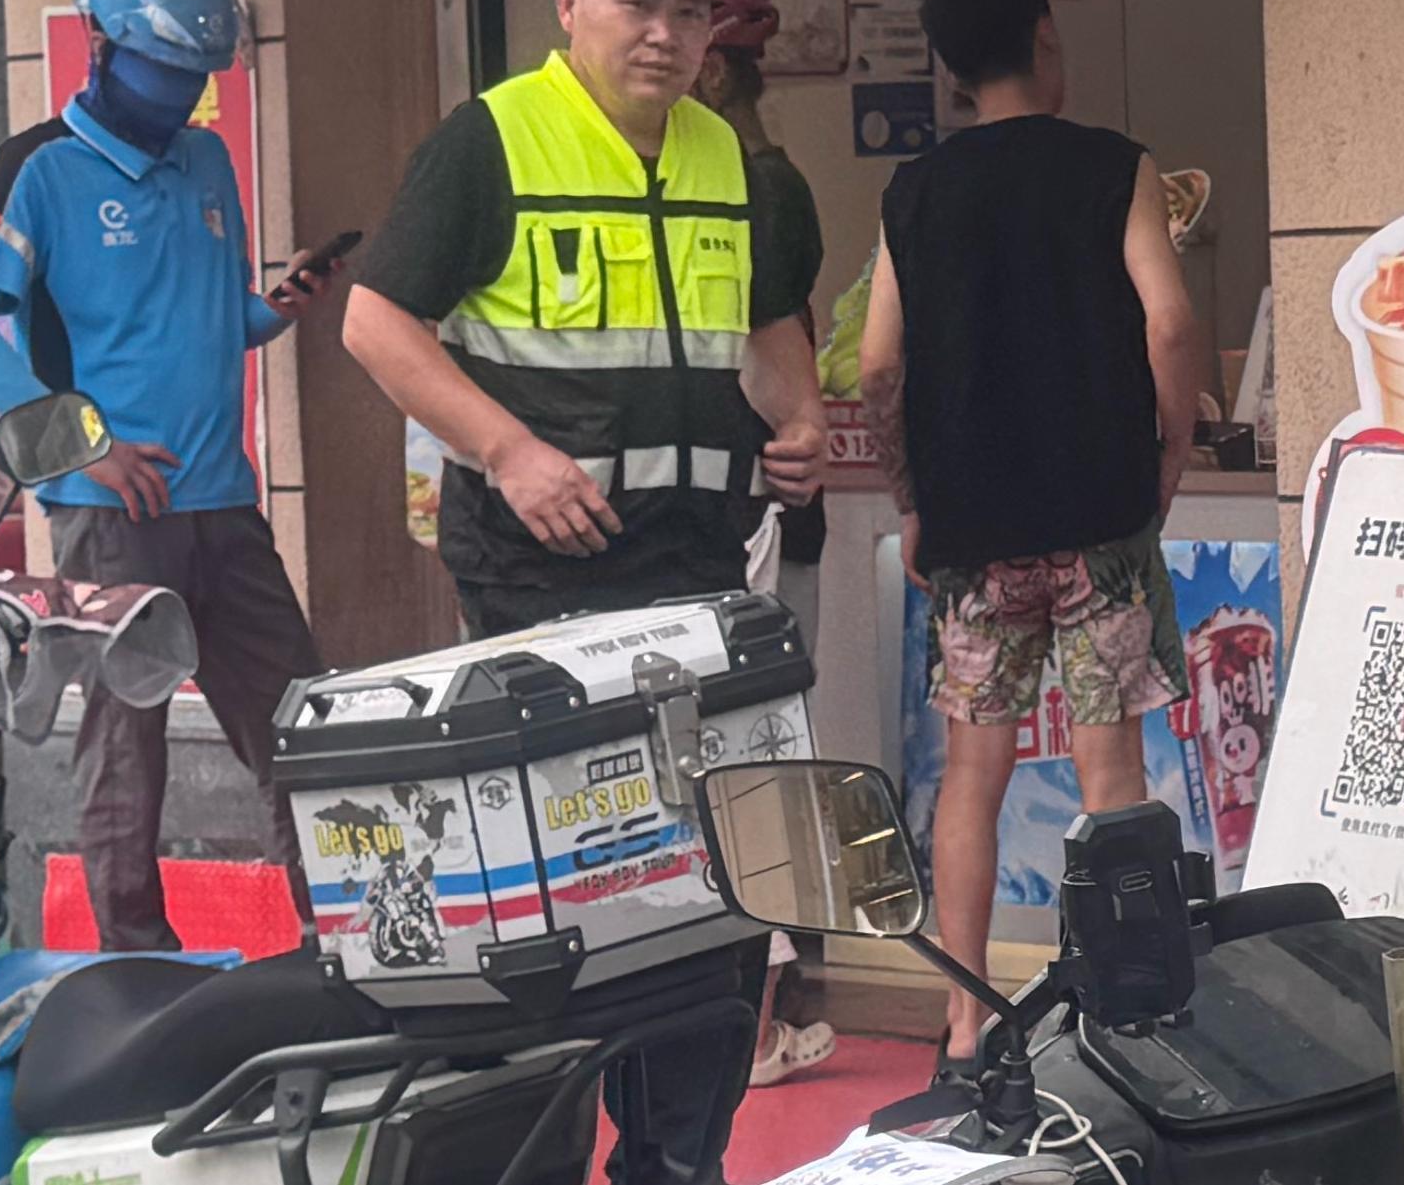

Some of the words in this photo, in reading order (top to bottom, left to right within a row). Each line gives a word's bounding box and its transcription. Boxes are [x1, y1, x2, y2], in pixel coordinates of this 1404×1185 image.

[545, 787, 612, 830] Let's
[614, 777, 652, 815] go
[313, 821, 370, 859] Let's
[372, 823, 403, 856] go
